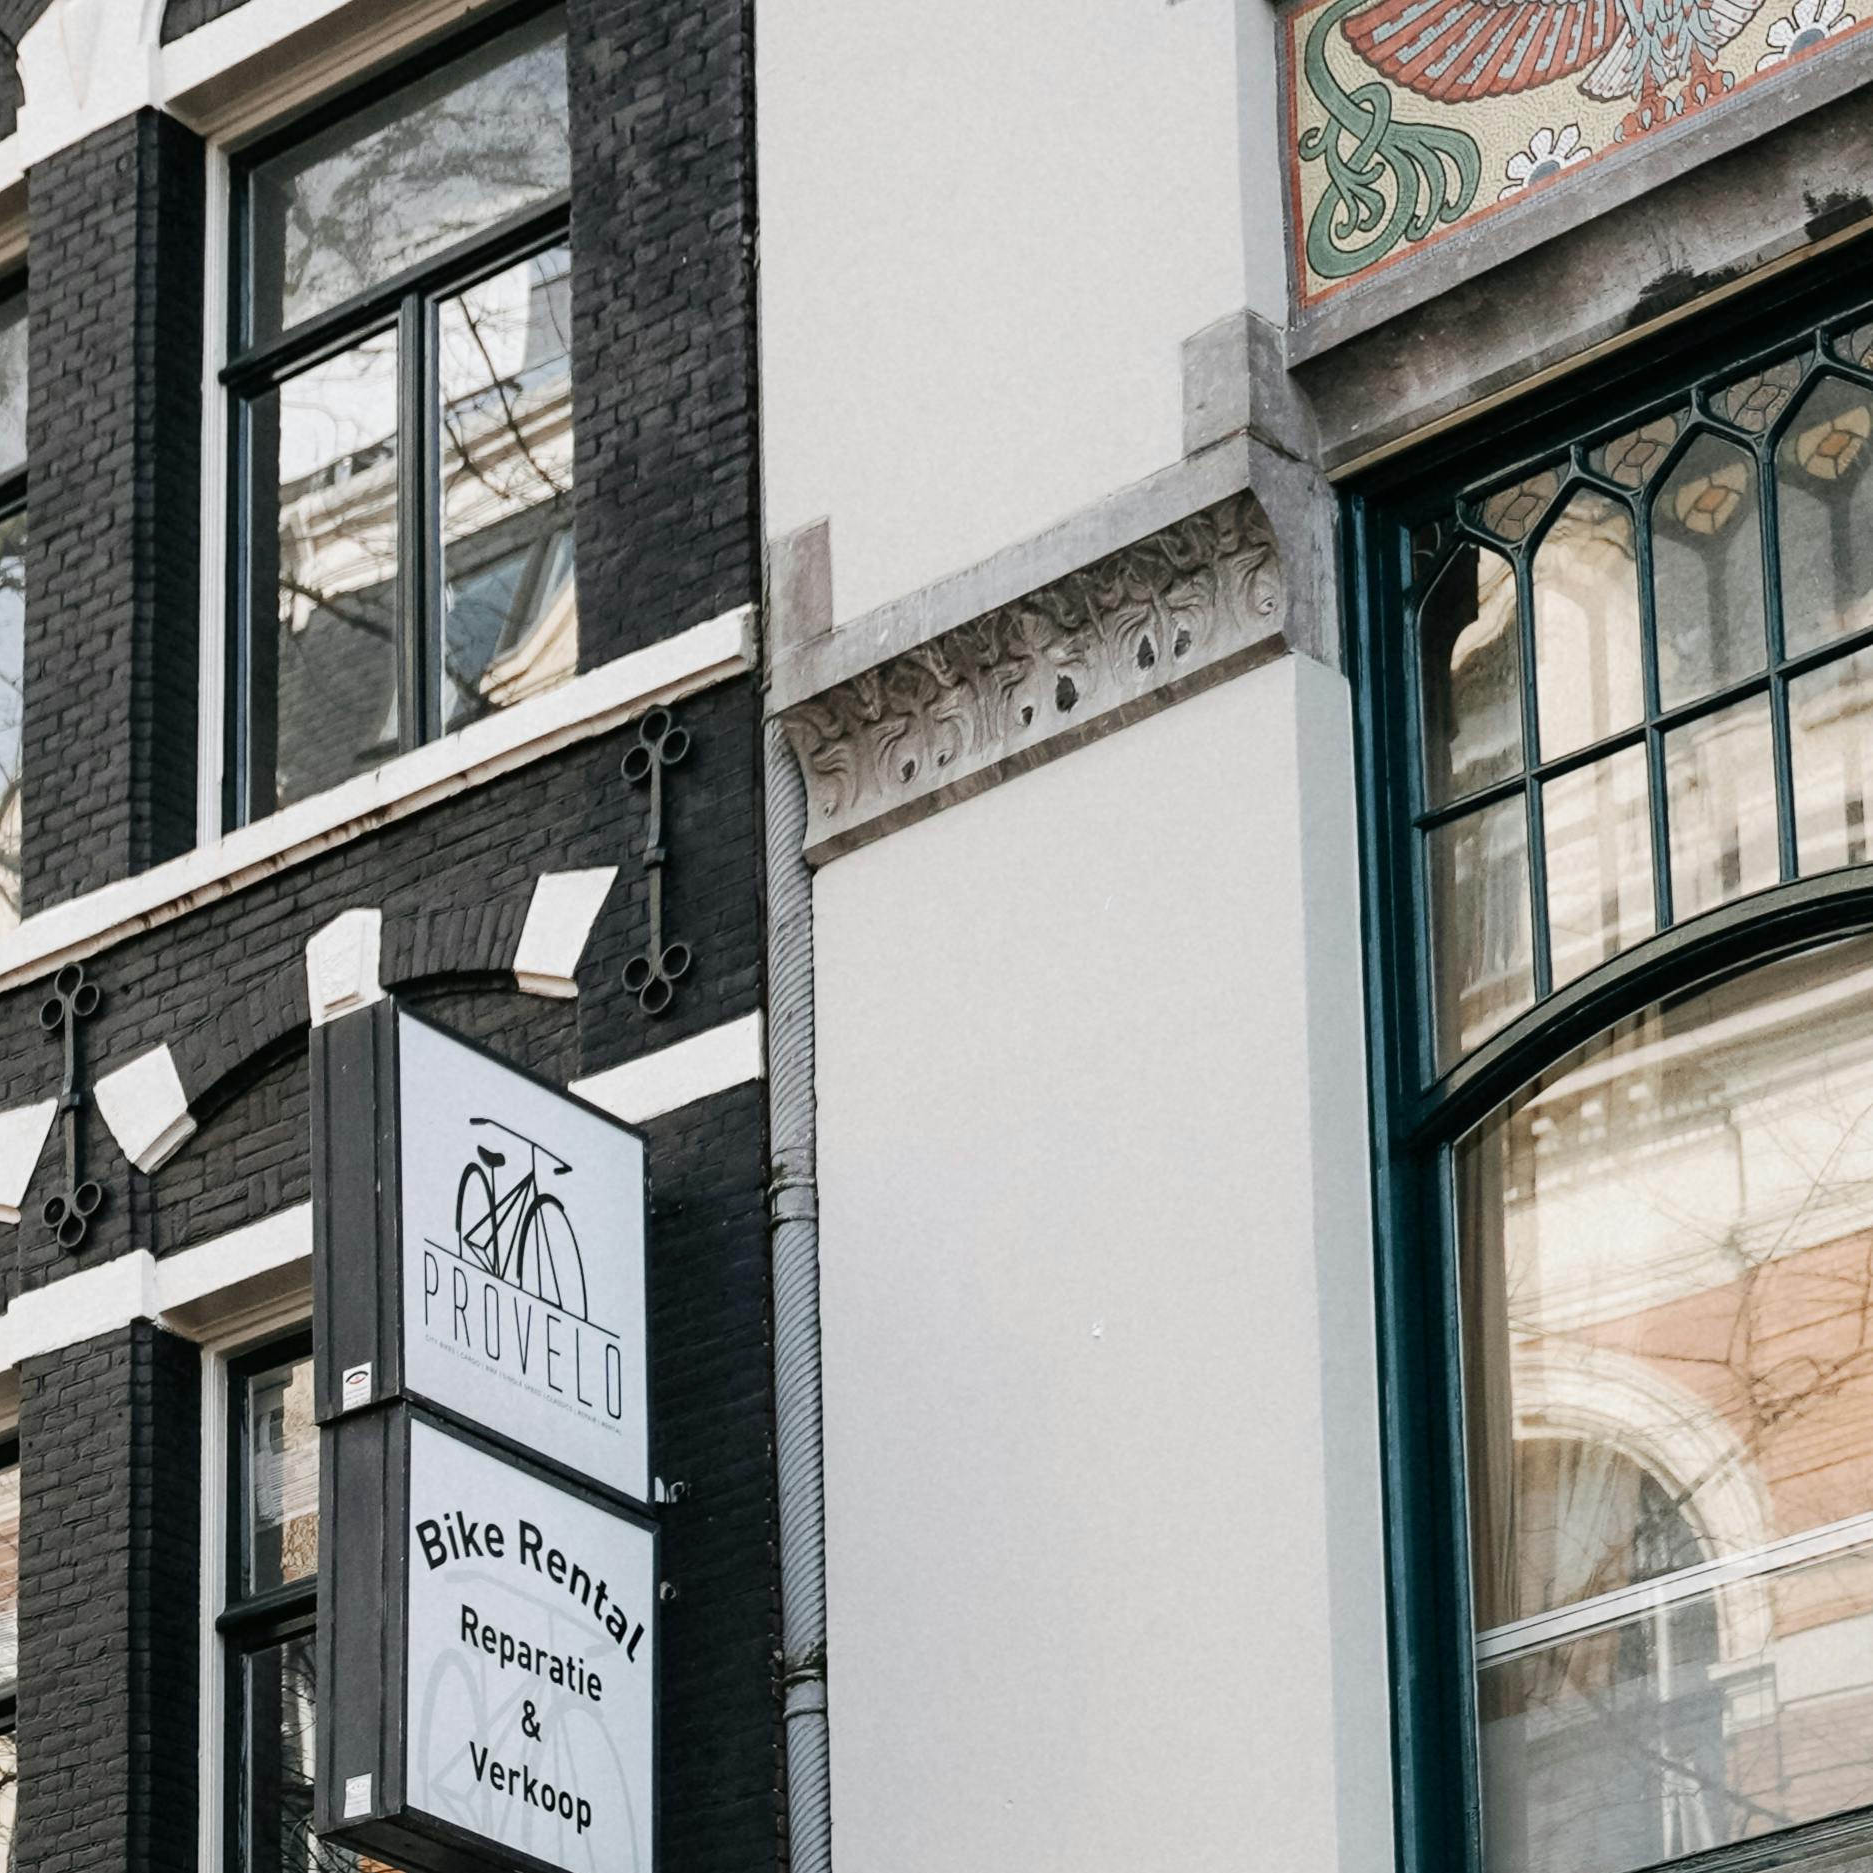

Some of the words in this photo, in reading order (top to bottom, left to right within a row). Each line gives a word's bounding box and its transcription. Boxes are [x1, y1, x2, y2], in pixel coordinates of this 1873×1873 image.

[423, 1250, 622, 1421] PROVELO
[416, 1511, 504, 1571] Bike
[520, 1519, 645, 1664] Rental
[460, 1605, 603, 1703] Reparatie
[521, 1701, 542, 1742] &
[469, 1741, 593, 1833] Verkoop
